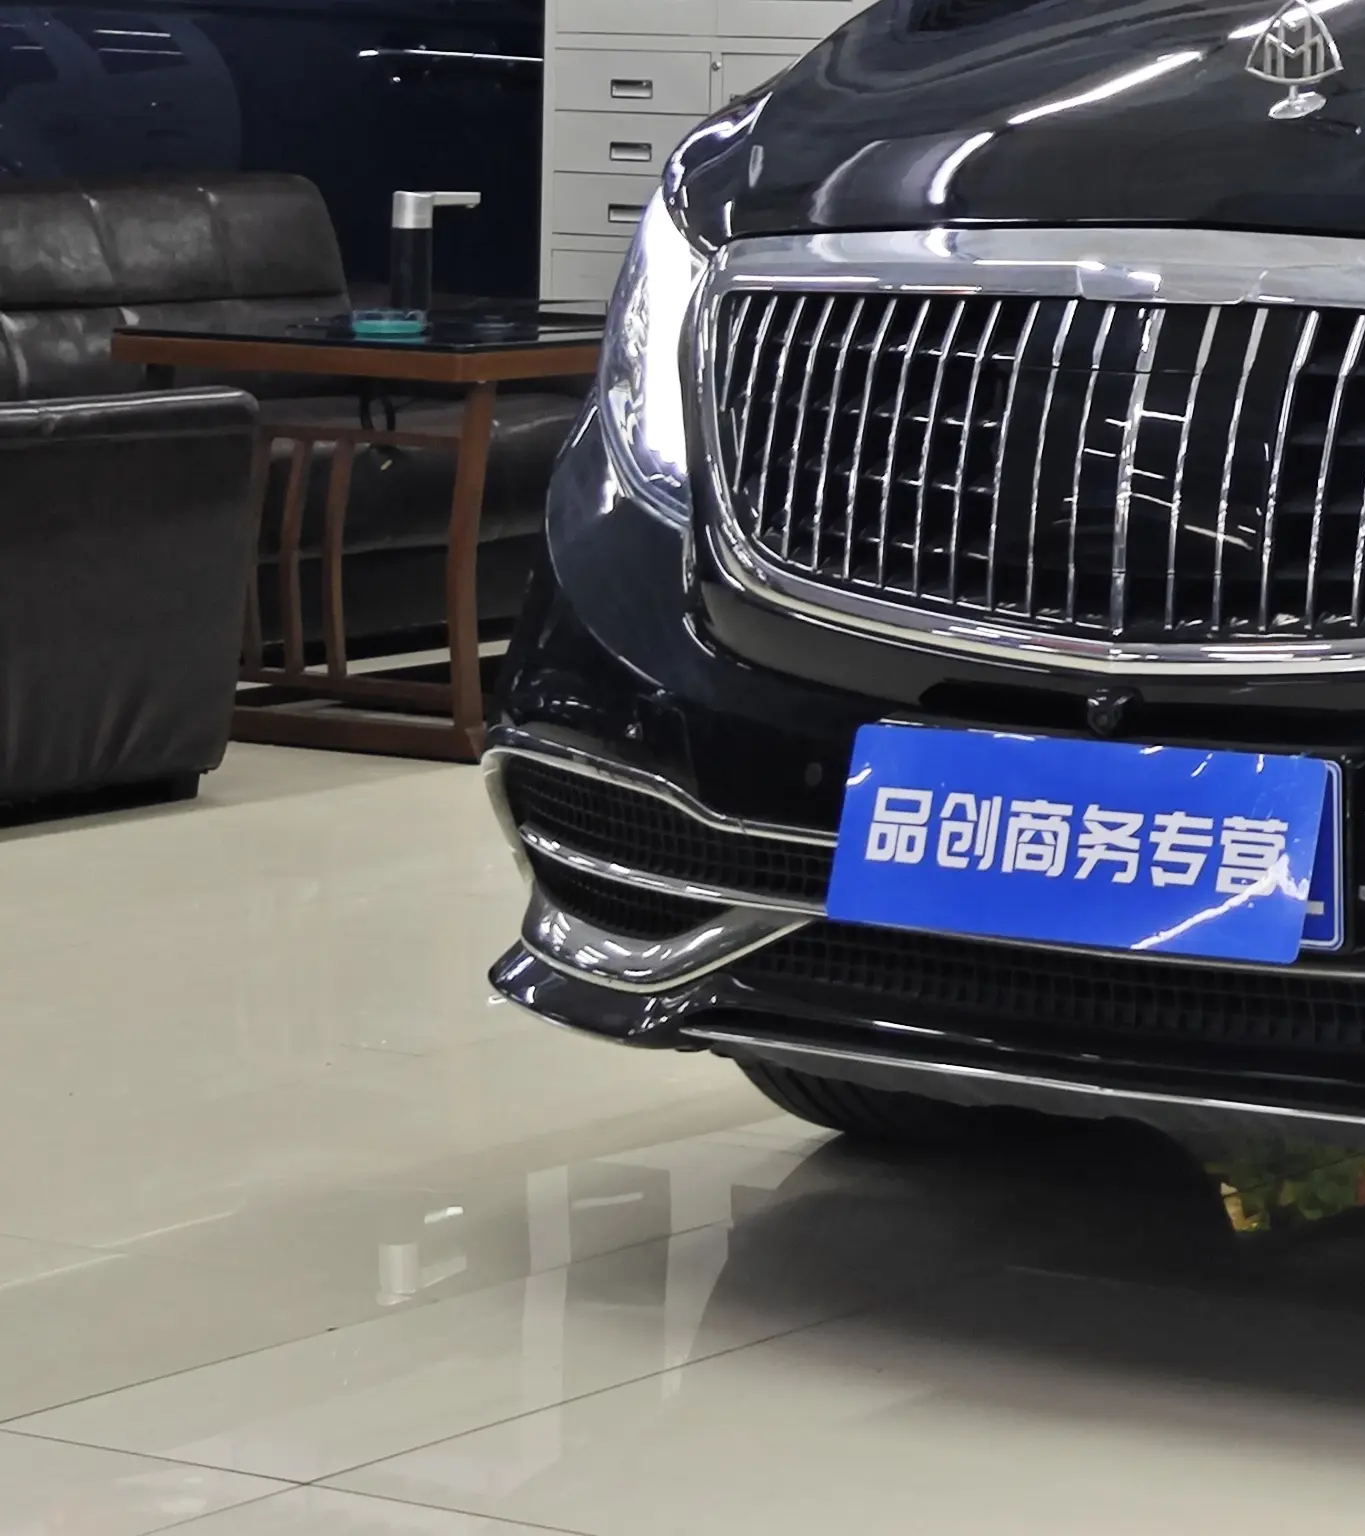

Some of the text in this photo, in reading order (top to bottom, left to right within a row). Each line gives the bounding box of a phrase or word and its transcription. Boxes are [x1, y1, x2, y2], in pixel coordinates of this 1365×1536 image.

[865, 786, 1288, 896] 品创商务专营
